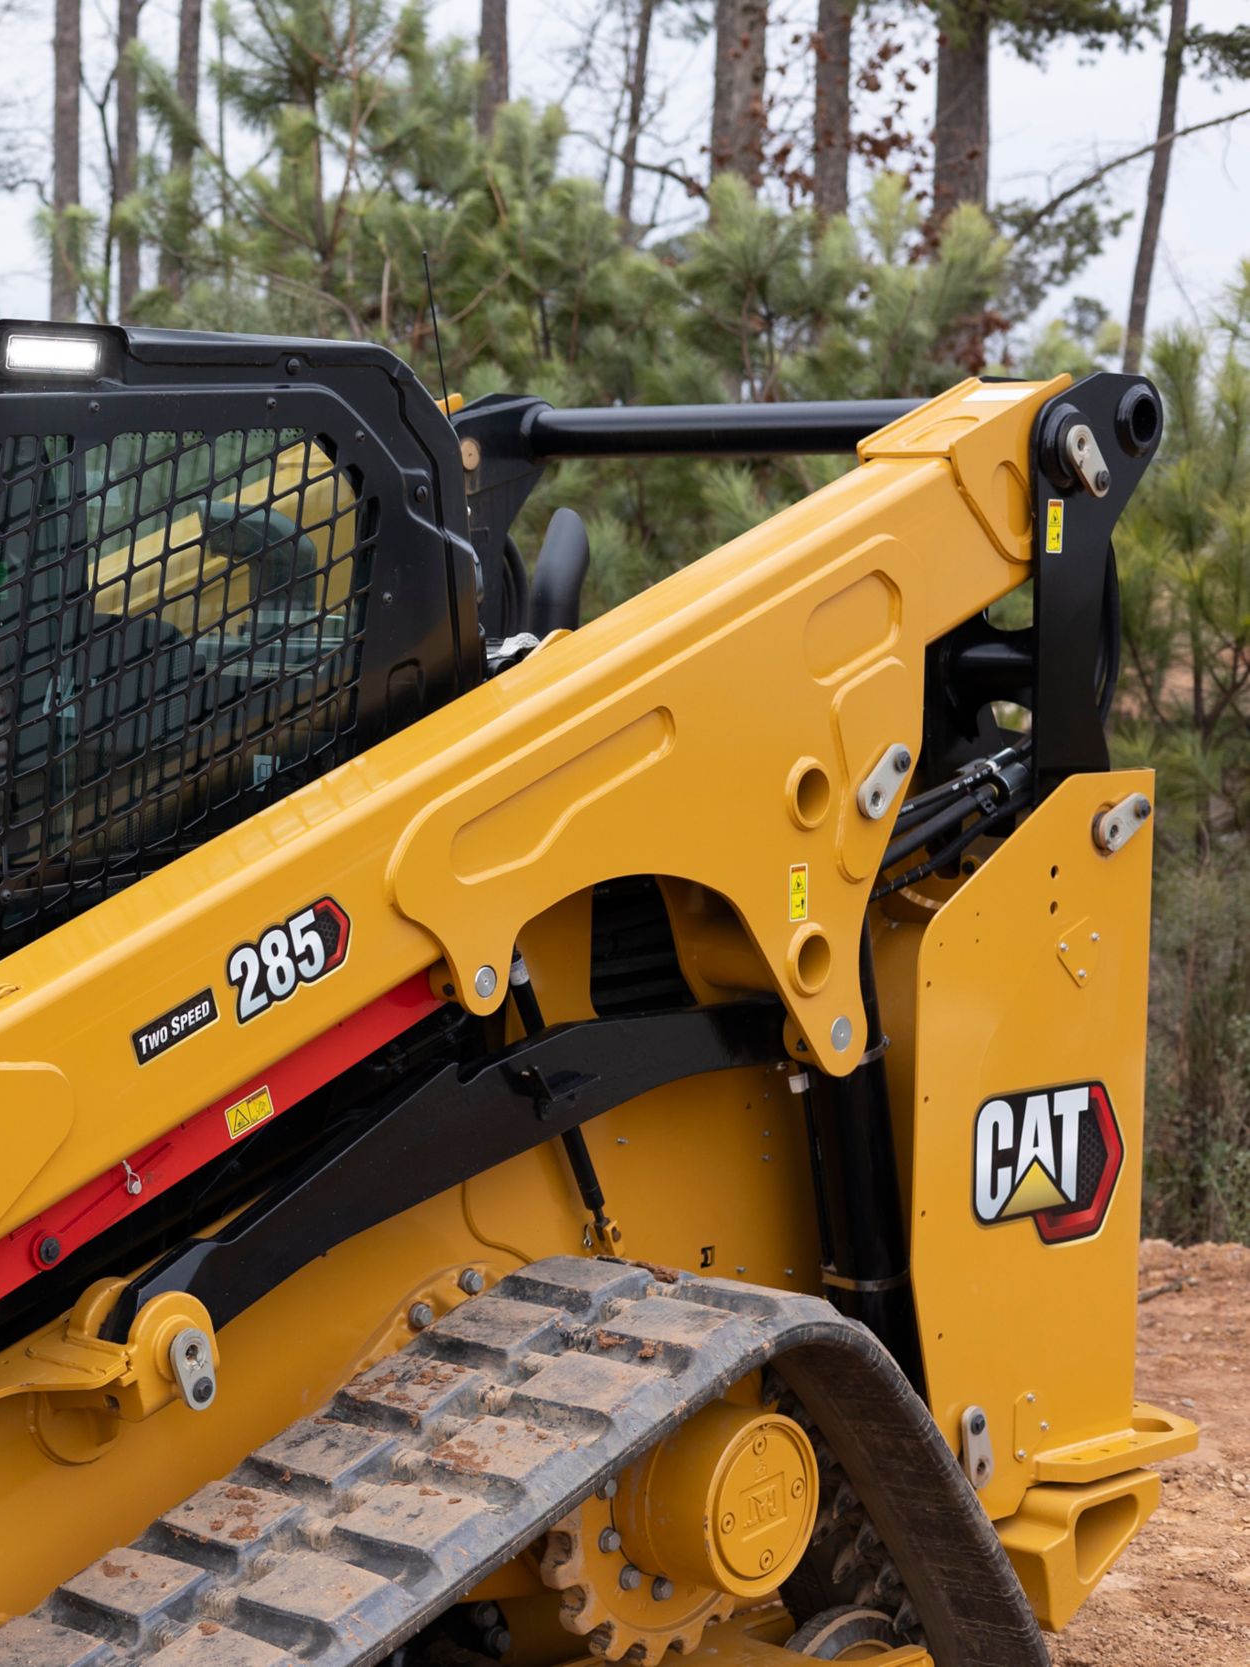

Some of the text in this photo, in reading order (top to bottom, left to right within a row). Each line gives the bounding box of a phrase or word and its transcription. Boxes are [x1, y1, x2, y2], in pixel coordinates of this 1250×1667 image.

[229, 908, 325, 1019] 285
[139, 1000, 210, 1055] TWO SPEED
[976, 1087, 1089, 1220] CAT
